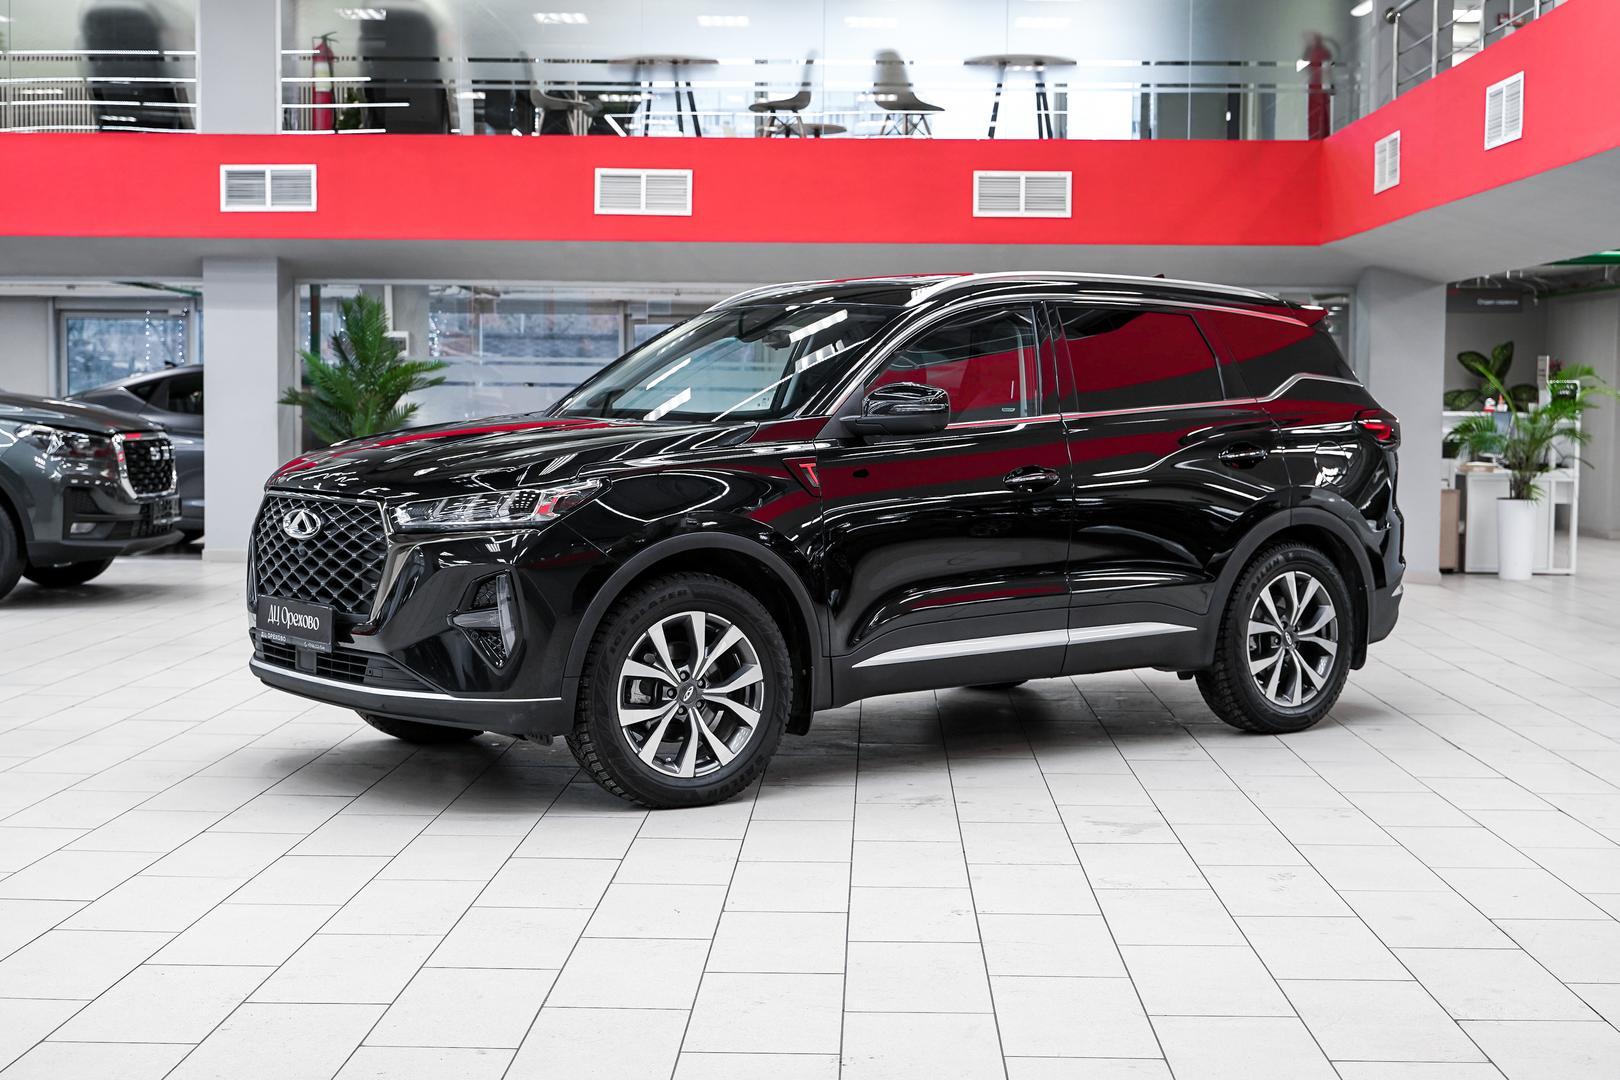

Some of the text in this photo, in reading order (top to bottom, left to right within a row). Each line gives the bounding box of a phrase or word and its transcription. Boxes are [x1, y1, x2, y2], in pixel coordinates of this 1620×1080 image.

[267, 604, 320, 631] ДЦ Орехово
[630, 589, 689, 625] BLAZER
